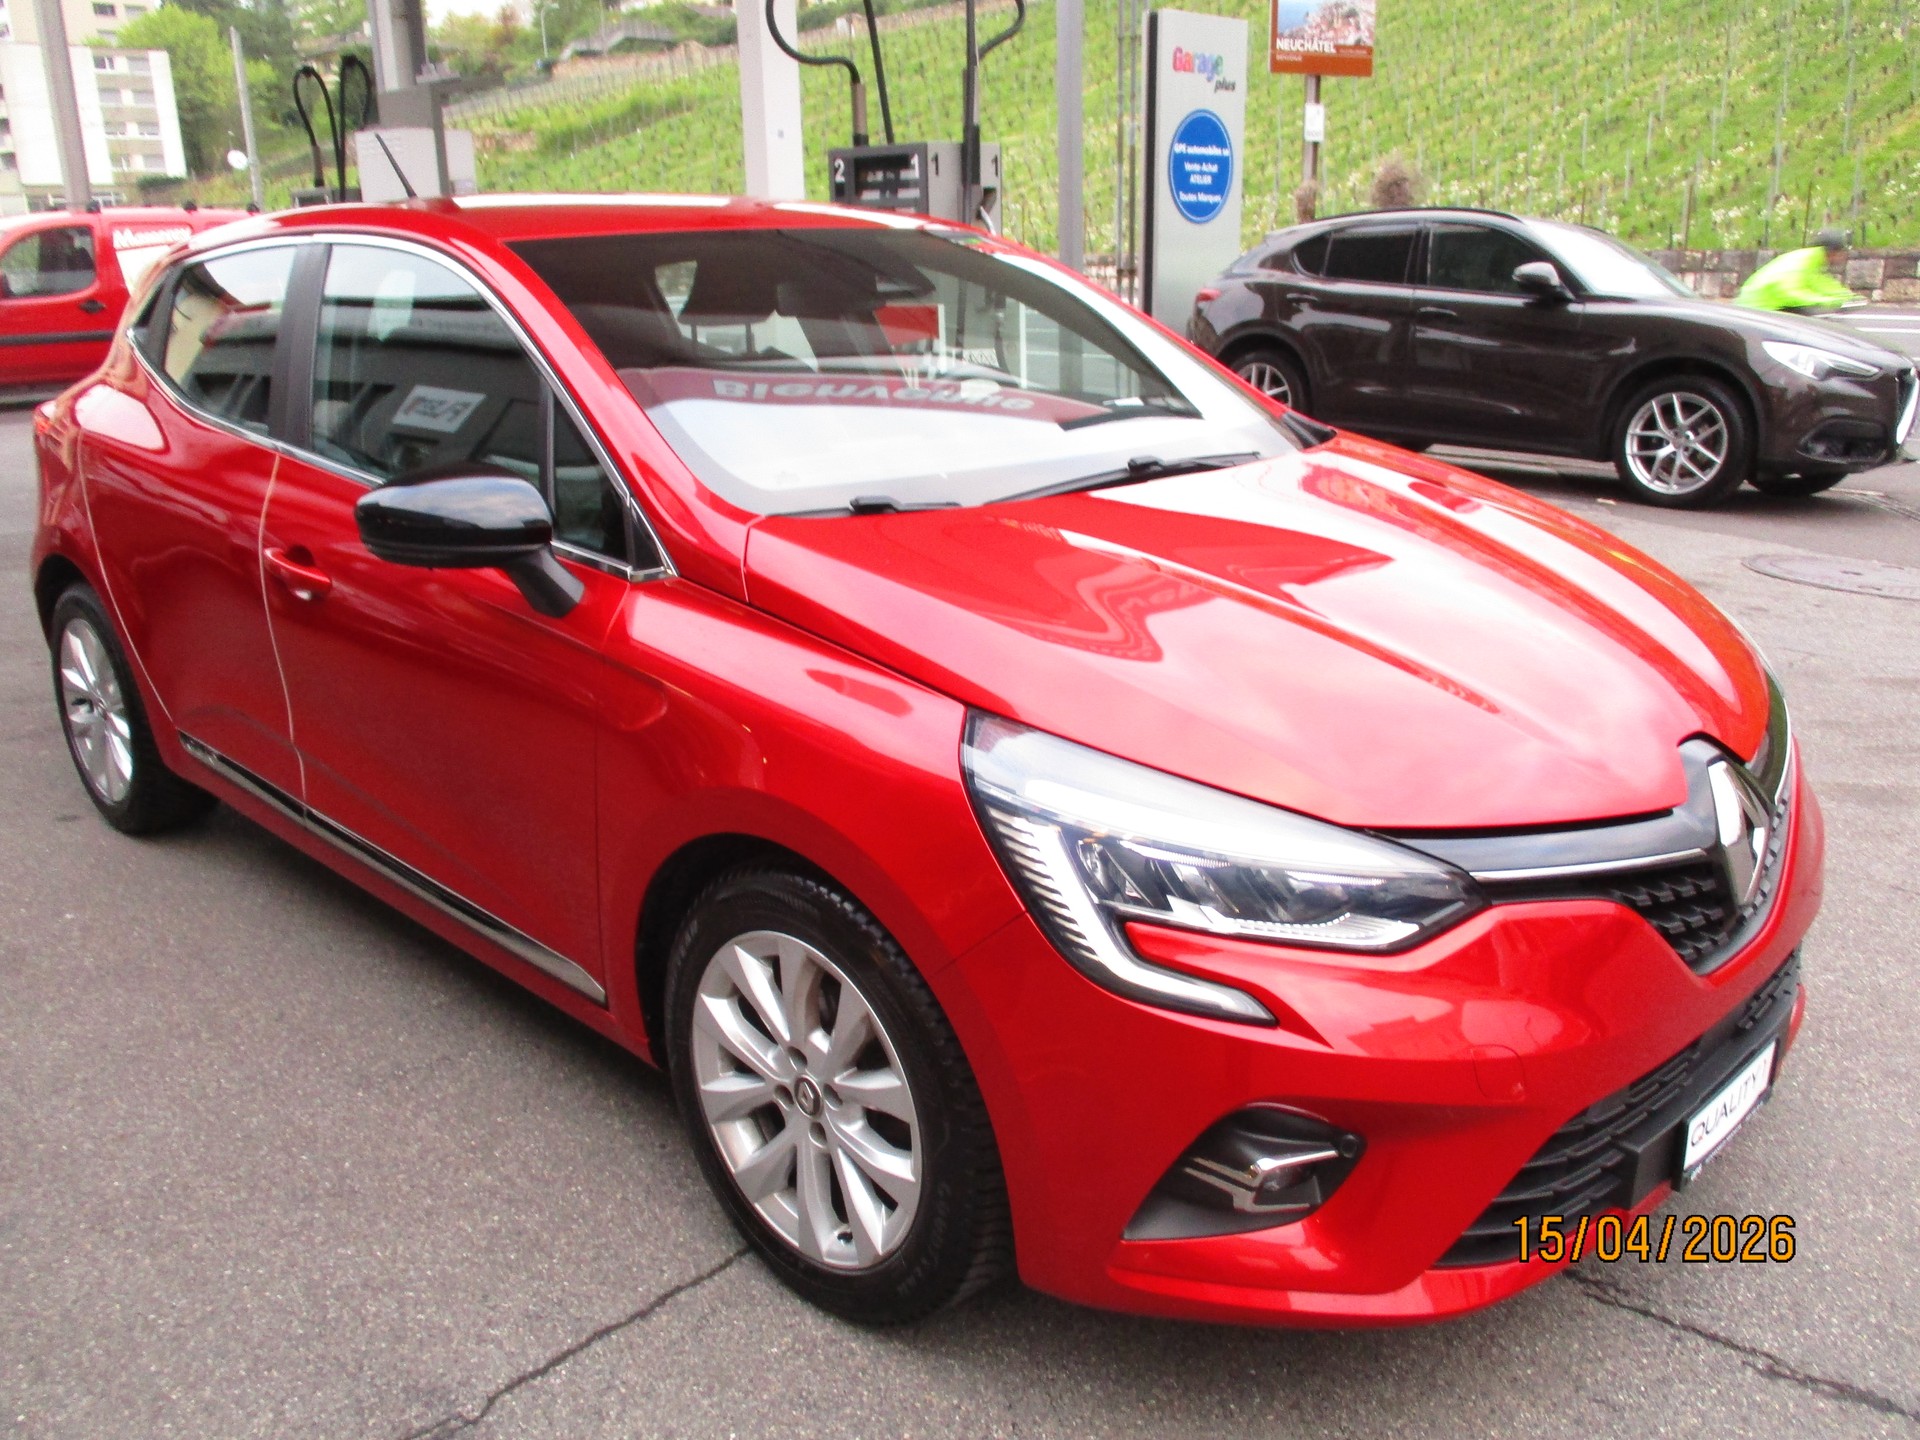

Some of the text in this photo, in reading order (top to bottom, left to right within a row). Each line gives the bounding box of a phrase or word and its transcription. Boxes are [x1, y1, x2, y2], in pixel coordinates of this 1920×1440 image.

[1276, 37, 1336, 53] NEUCHÂTEL
[1172, 47, 1223, 82] Garage
[1214, 77, 1236, 94] plus
[834, 158, 845, 182] 2
[911, 153, 920, 179] 1
[931, 153, 940, 176] 1
